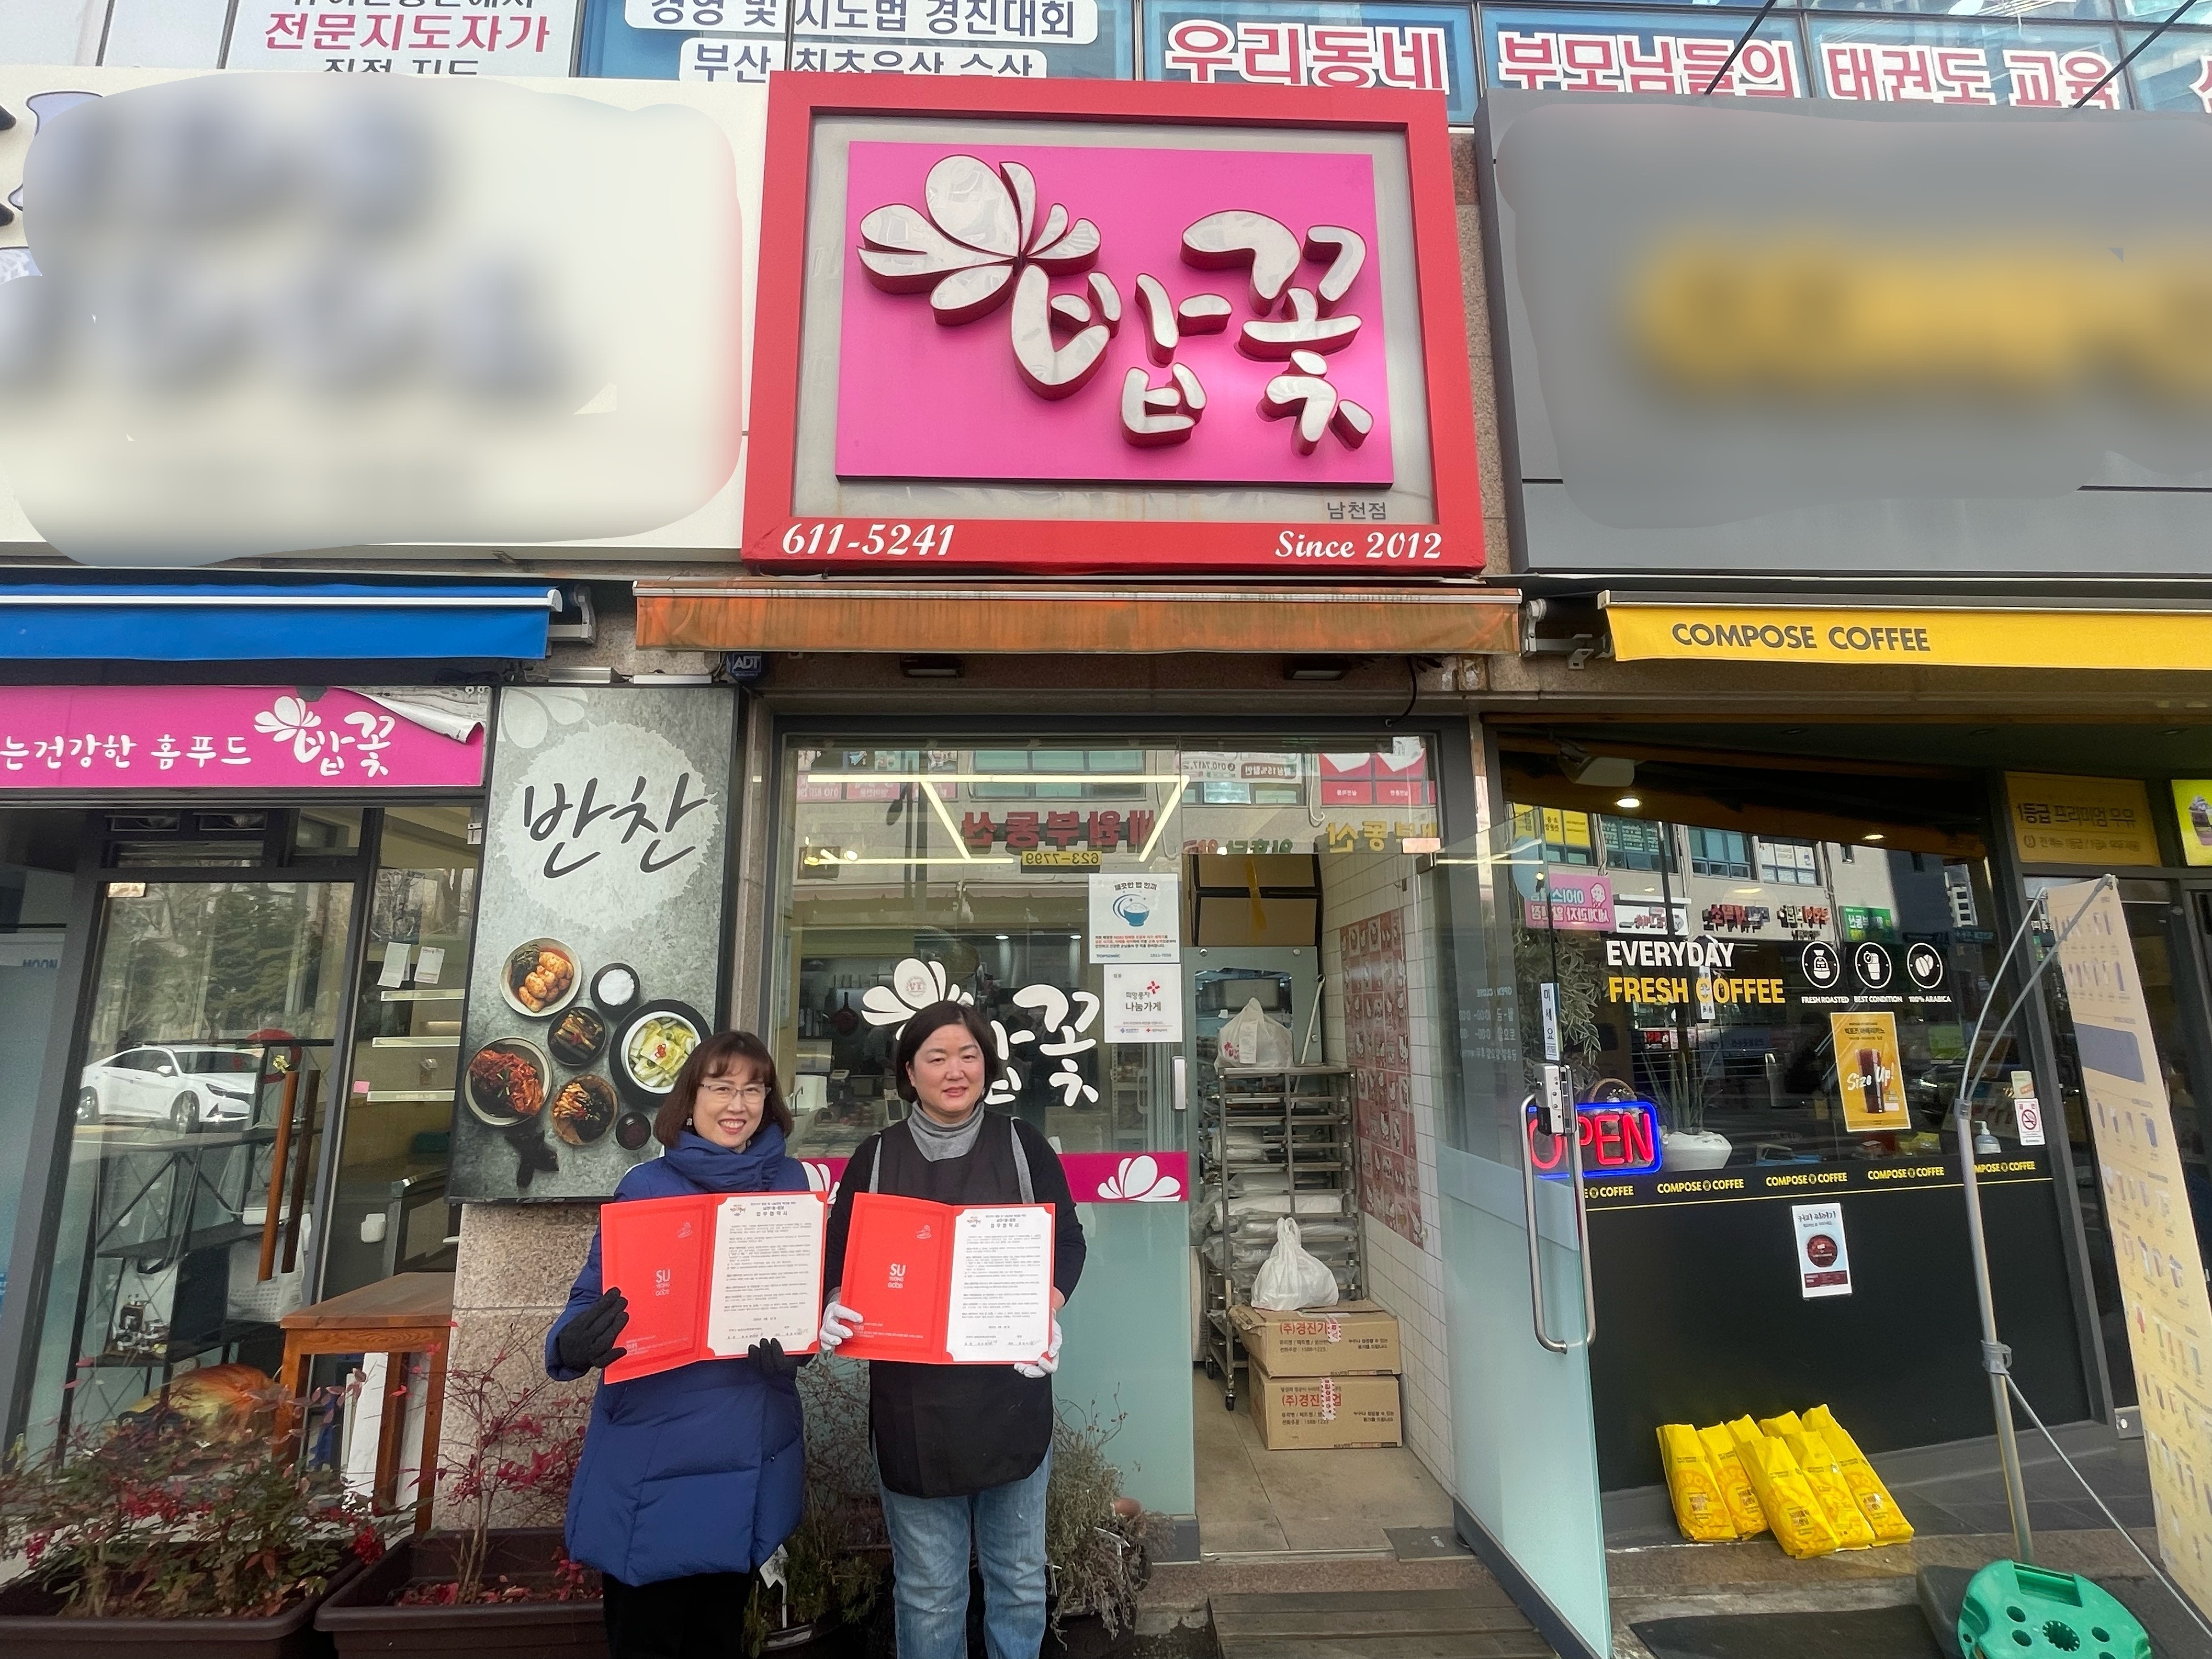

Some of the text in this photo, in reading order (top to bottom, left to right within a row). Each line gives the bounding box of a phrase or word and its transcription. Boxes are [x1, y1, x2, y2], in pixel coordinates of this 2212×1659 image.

[265, 13, 550, 52] 전문지도자가
[926, 0, 1074, 38] 경진대회
[694, 44, 770, 83] 부산
[1169, 23, 1447, 89] 우리동네
[1502, 33, 1796, 98] 부모님들의
[1825, 45, 2118, 109] 태권도 교육
[1011, 210, 1374, 450] 밥꽃
[1327, 501, 1386, 520] 남천점
[782, 523, 956, 557] 611-5241
[1274, 529, 1442, 558] Since 2012
[1672, 623, 1930, 652] COMPOSE COFFEE
[733, 656, 761, 669] ADT
[150, 733, 252, 770] 홈푸드
[294, 711, 396, 777] 밥꽃
[523, 772, 708, 879] 반찬
[1606, 940, 1735, 967] EVERYDAY
[1609, 977, 1689, 1003] FRESH
[1695, 978, 1786, 1003] COFFEE
[1126, 1001, 1161, 1012] 나눔가게
[1544, 989, 1555, 1039] 미세요
[1847, 1062, 1895, 1091] Size Up!
[1766, 1172, 1848, 1187] COMPOSE COFFEE
[1867, 1166, 1944, 1180] COMPOSE COFFEE
[1975, 1161, 2036, 1173] MPOSE COFFEE
[1600, 1185, 1634, 1198] COFFEE
[1657, 1178, 1745, 1194] COMPOSE COFFEE
[656, 1269, 670, 1283] SU
[889, 1263, 906, 1277] SU
[1280, 1321, 1327, 1335] (주)경진기
[1282, 1393, 1342, 1407] (주)경진업
